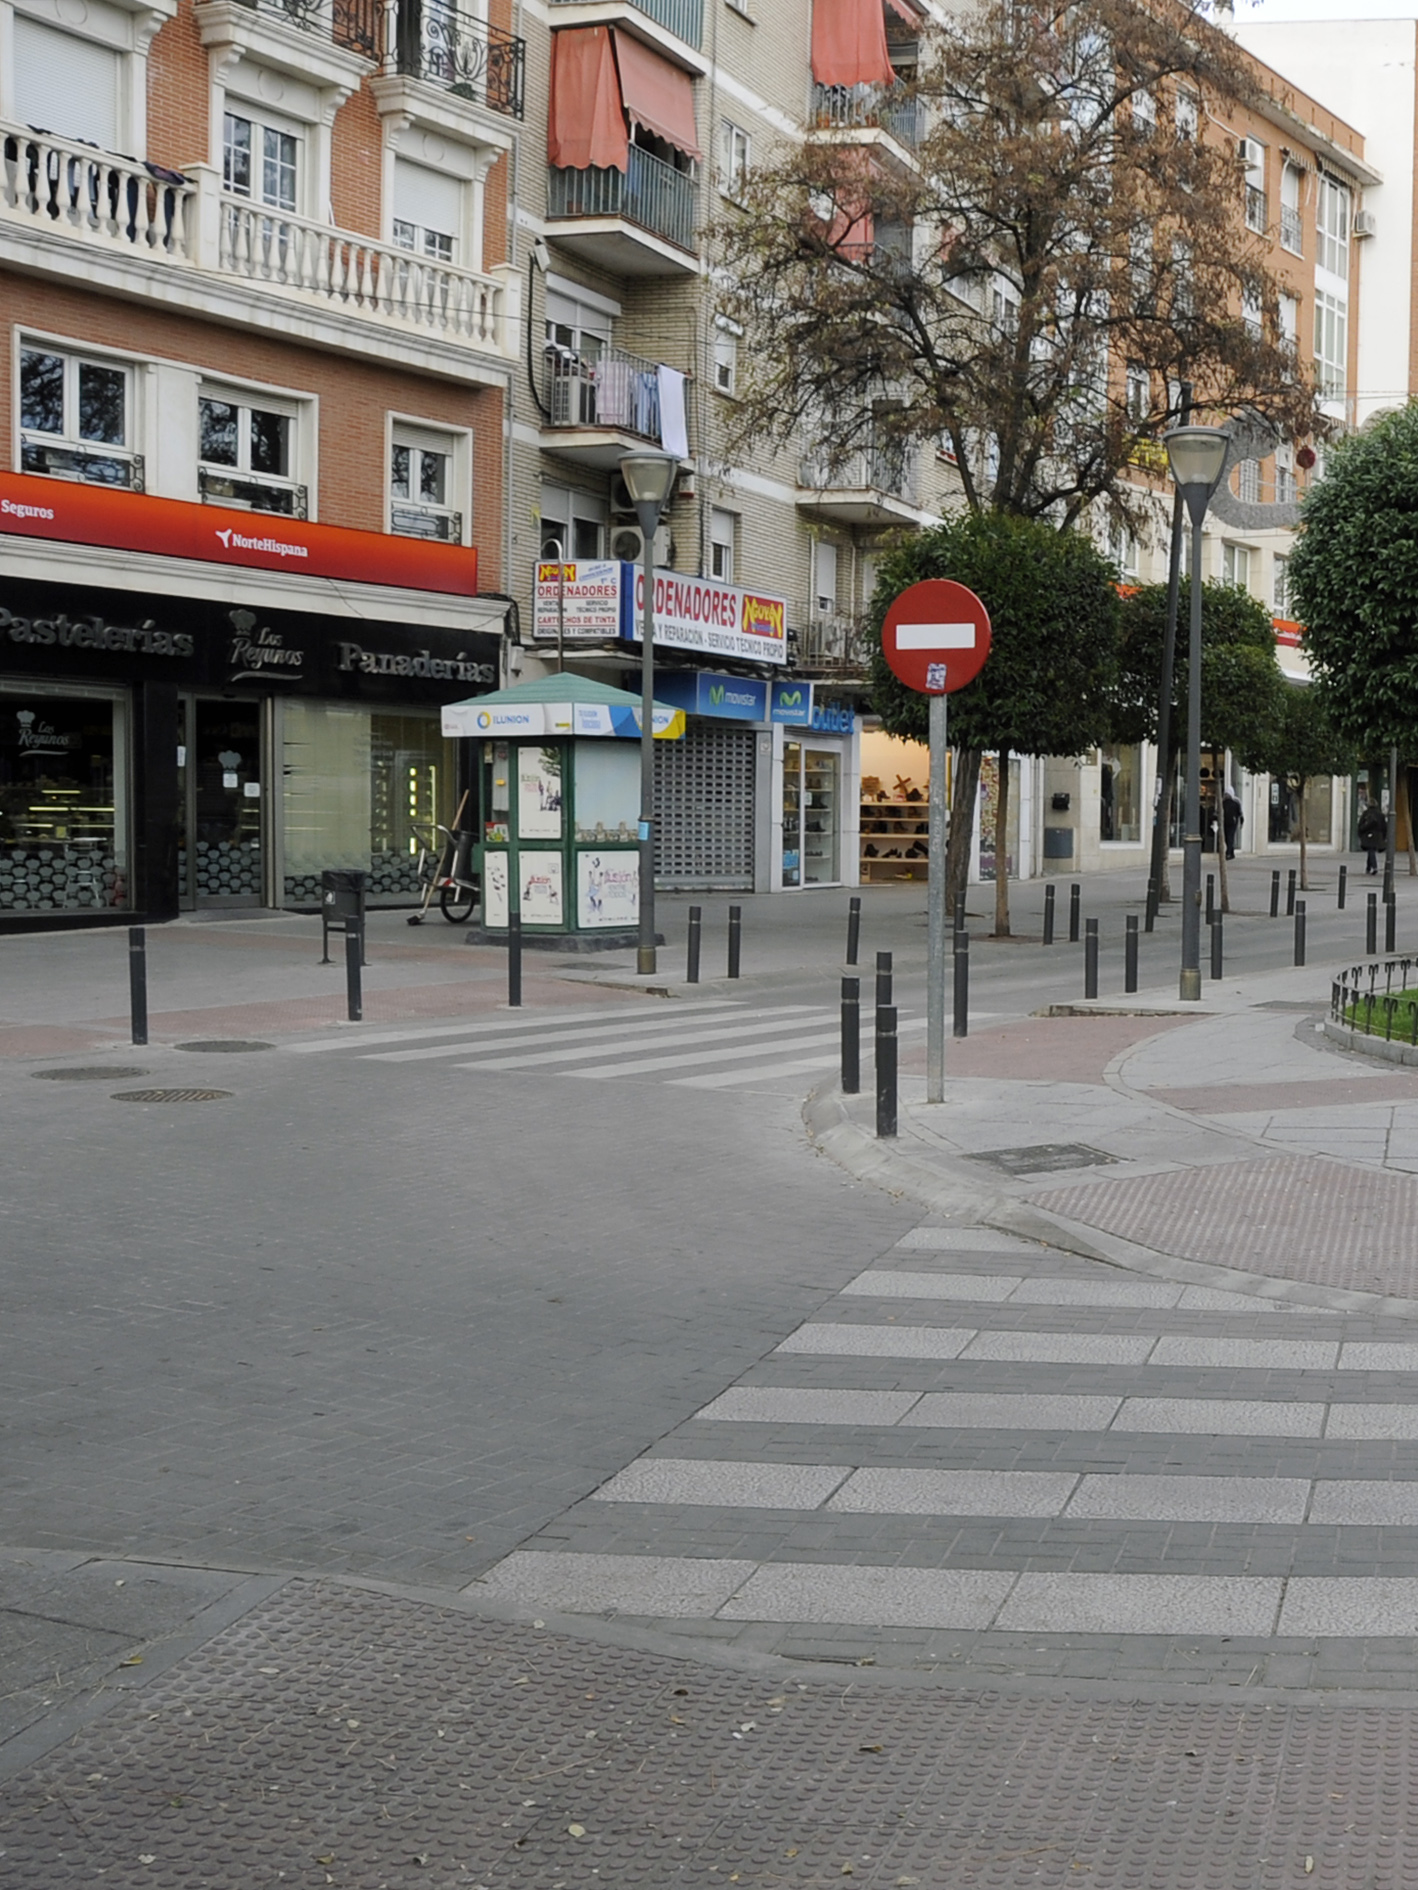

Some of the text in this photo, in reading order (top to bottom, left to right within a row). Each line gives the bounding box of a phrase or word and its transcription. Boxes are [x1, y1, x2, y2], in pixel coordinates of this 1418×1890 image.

[1, 499, 54, 519] Seguros
[232, 533, 308, 558] NorteHispana
[537, 585, 617, 596] ORDENADORES
[636, 574, 737, 628] ODENADORES
[583, 616, 616, 624] DE TINTA
[258, 627, 283, 647] Los
[231, 637, 304, 669] Reyunos
[338, 642, 495, 684] Panaderías
[725, 692, 756, 706] movistar
[493, 714, 529, 725] ILUNION
[772, 708, 806, 717] movistar
[812, 702, 856, 734] outlet
[38, 721, 55, 734] Los
[18, 728, 69, 748] Reyunos
